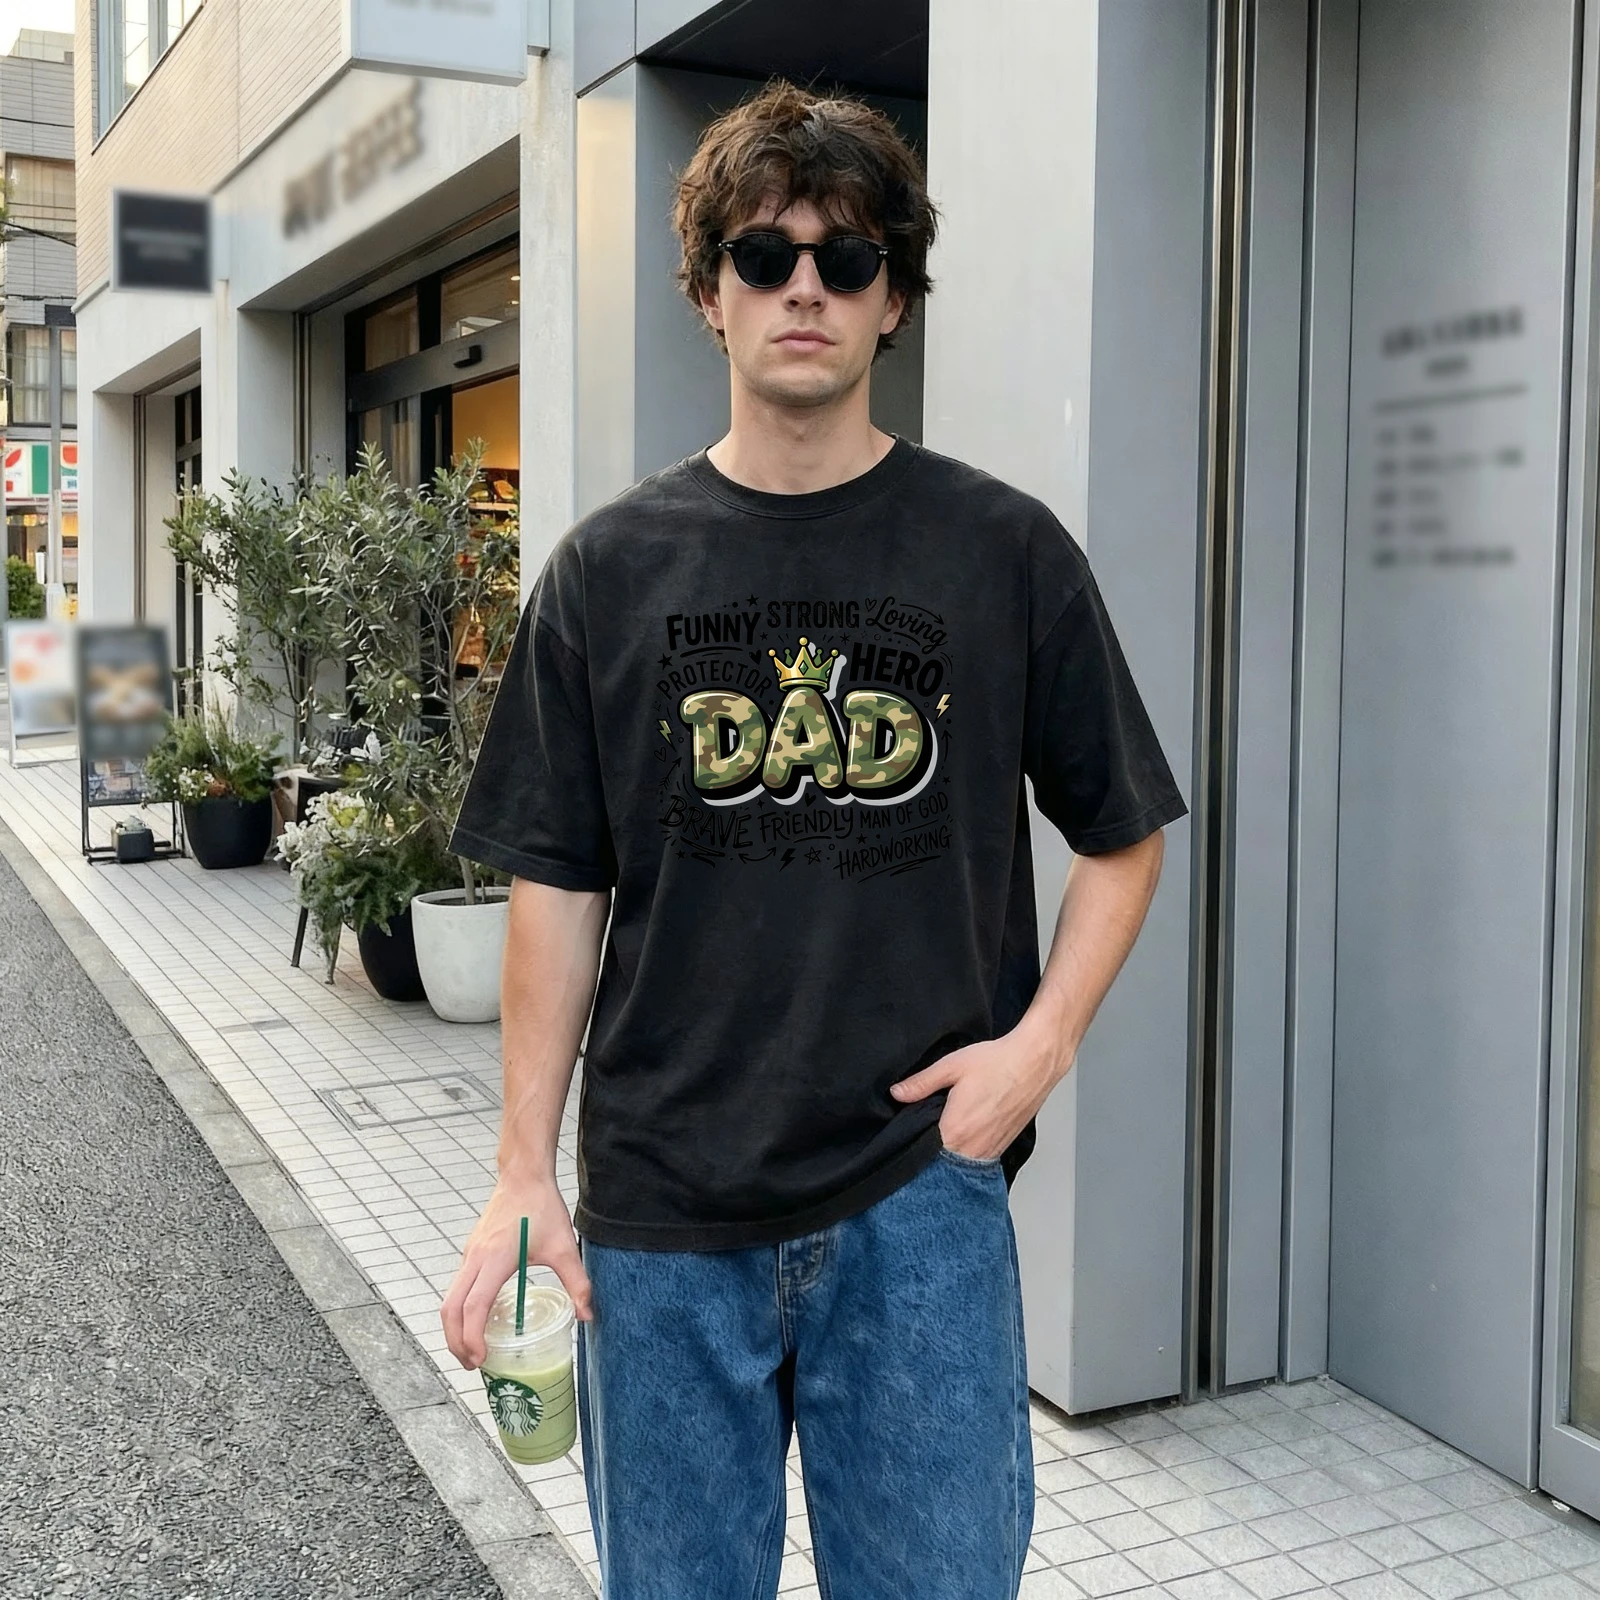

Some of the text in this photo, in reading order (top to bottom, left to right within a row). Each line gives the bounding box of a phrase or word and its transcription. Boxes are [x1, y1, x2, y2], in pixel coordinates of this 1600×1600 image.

[666, 611, 761, 651] FUNNY
[767, 600, 860, 629] STRONG
[866, 596, 948, 655] Loving
[656, 659, 773, 701] PROTECTOR
[849, 641, 943, 698] HERO
[677, 687, 933, 803] DAD
[658, 794, 754, 849] BRAVE
[860, 791, 949, 829] MAN OF GOD
[832, 824, 953, 880] HARDWORKING
